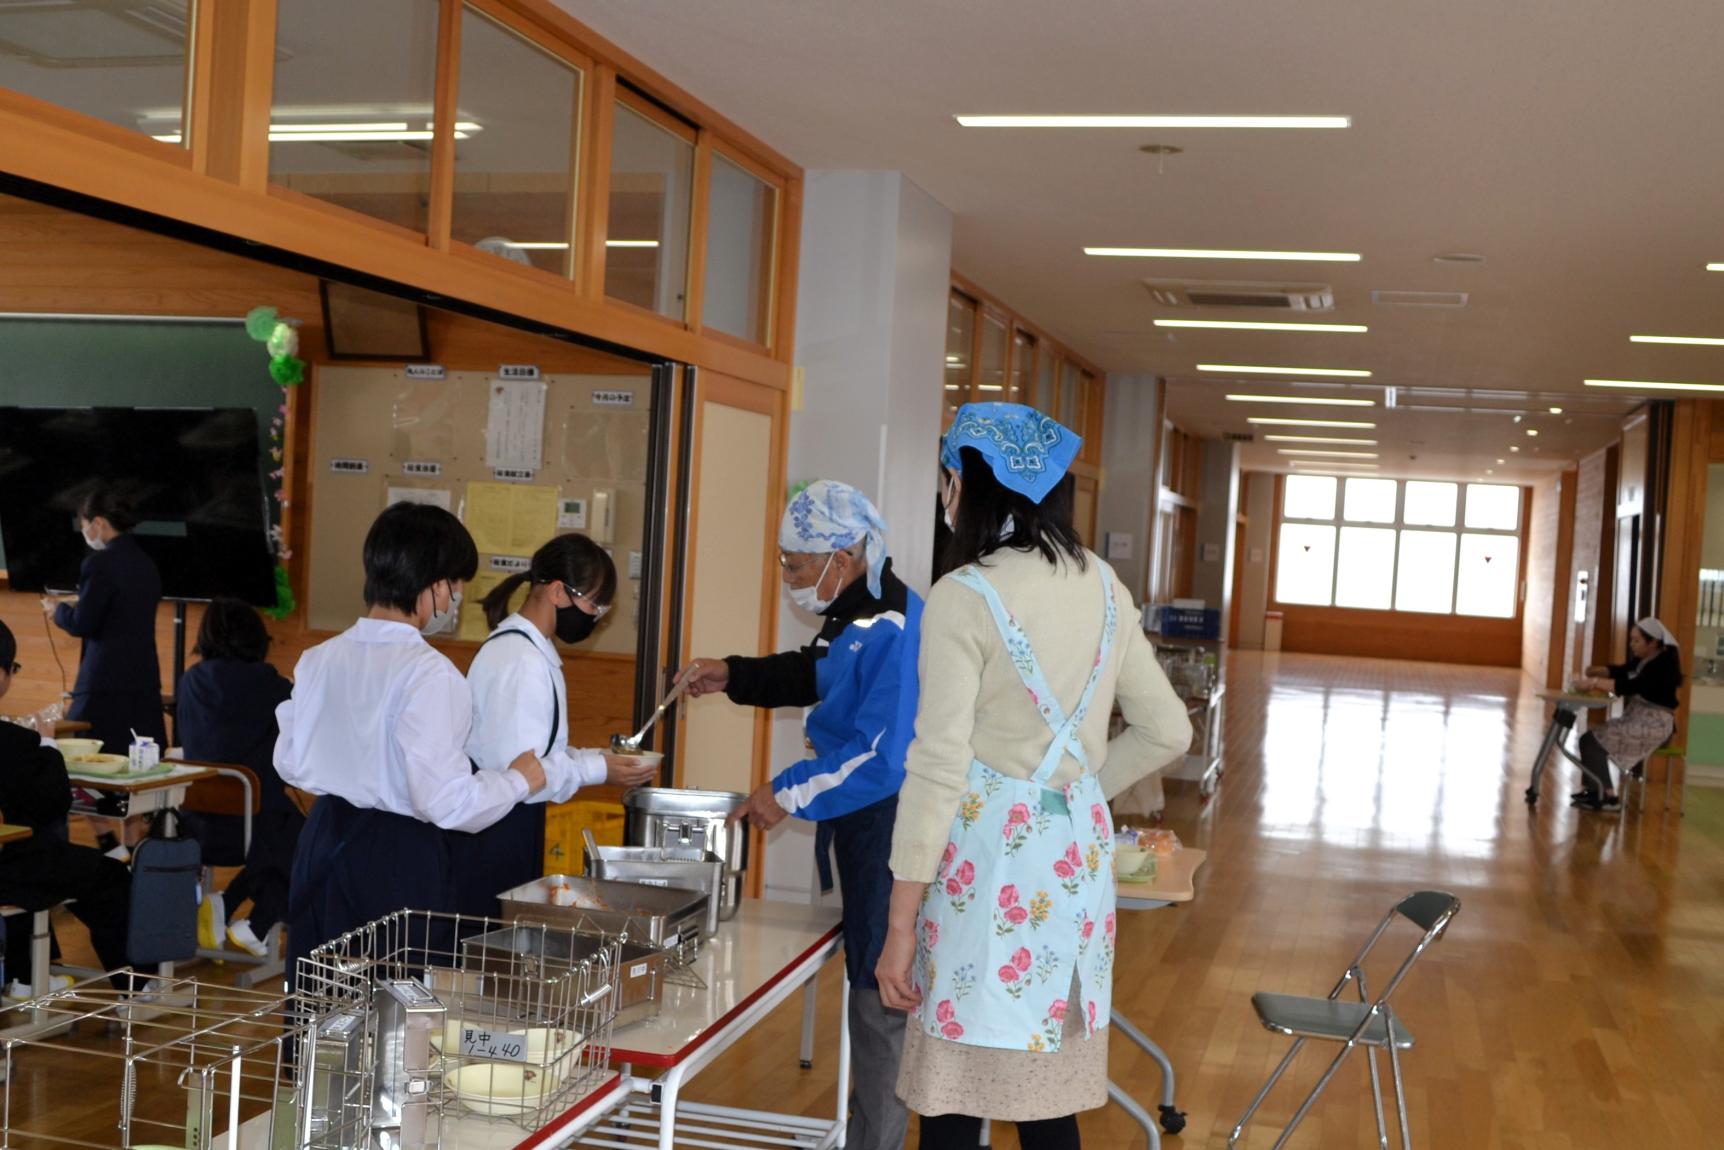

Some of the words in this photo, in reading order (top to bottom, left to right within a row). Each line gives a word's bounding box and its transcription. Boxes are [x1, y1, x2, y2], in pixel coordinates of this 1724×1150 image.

[595, 394, 630, 403] 今月の予定
[463, 1029, 491, 1046] 見中
[502, 1043, 521, 1057] 40
